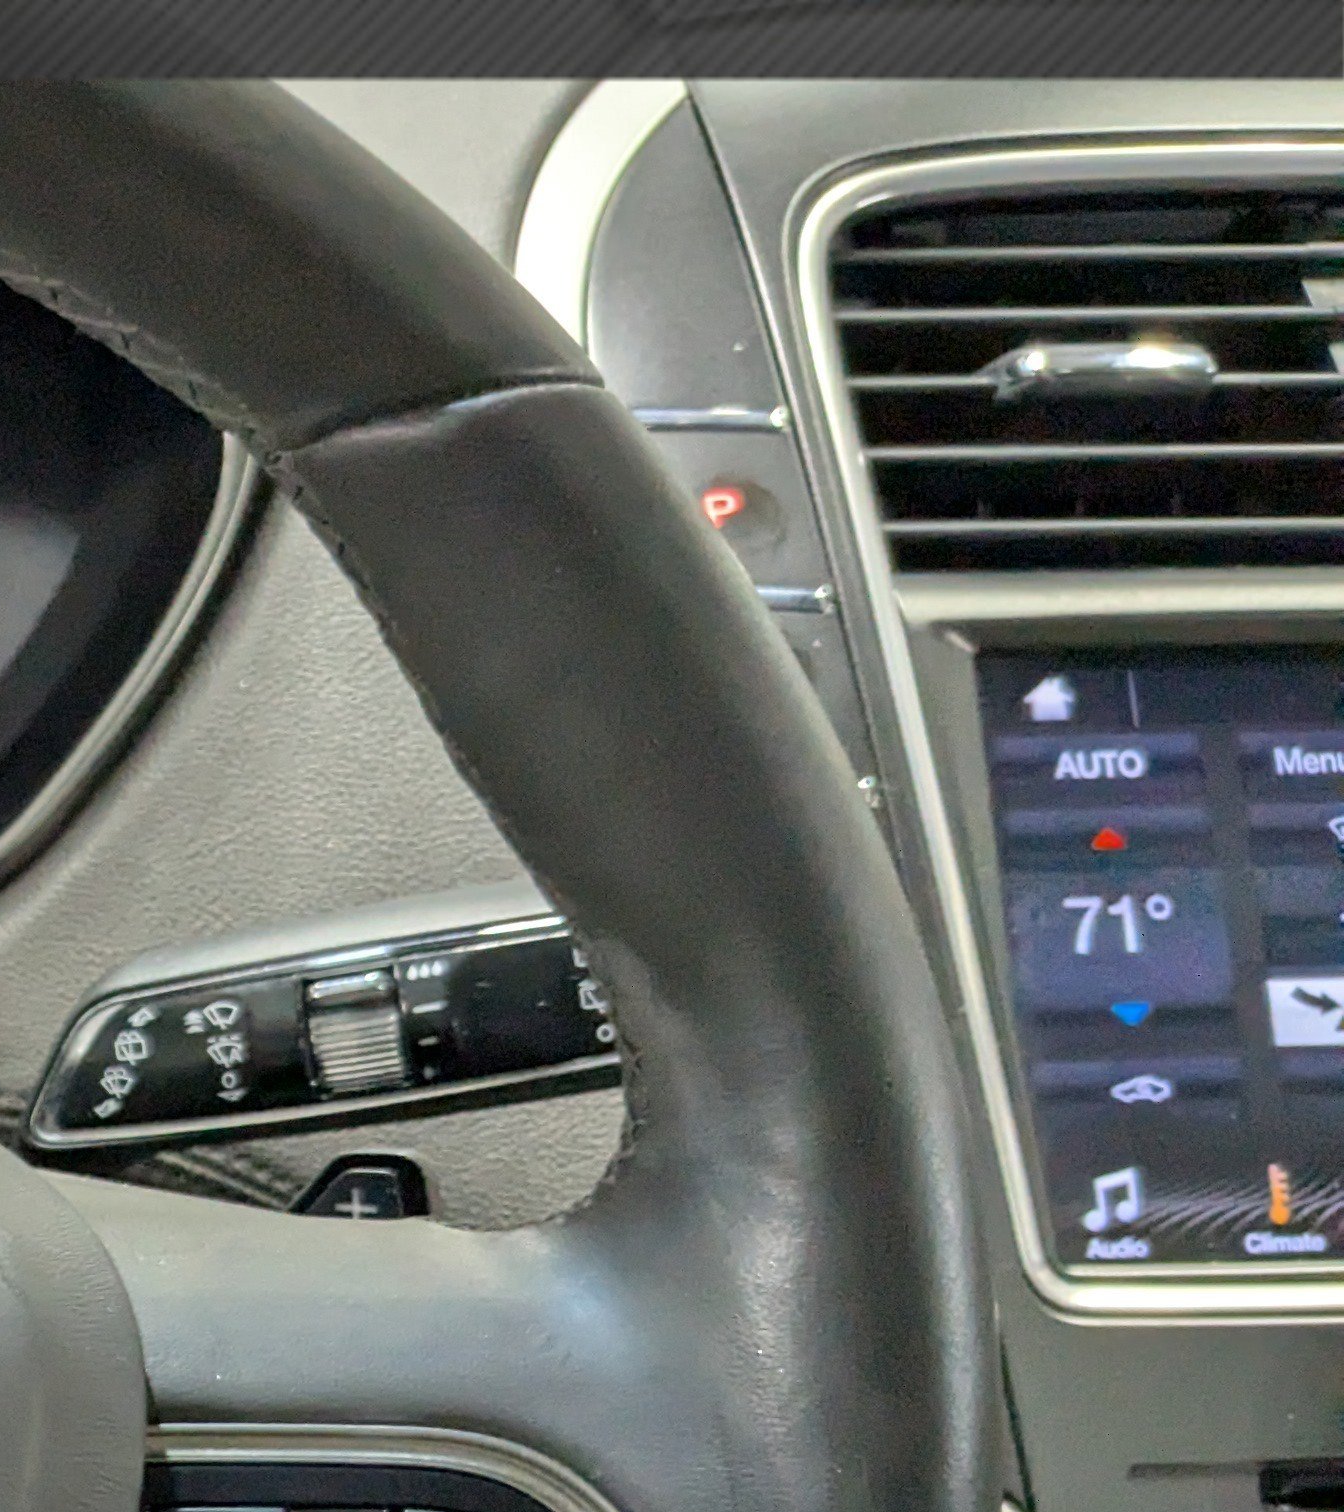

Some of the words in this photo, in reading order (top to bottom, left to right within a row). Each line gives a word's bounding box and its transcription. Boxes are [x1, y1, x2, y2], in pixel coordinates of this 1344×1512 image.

[701, 488, 744, 528] P
[1055, 750, 1146, 780] AUTO
[1062, 895, 1173, 955] 71°
[1087, 1236, 1149, 1262] Audio
[1244, 1230, 1326, 1257] Climate
